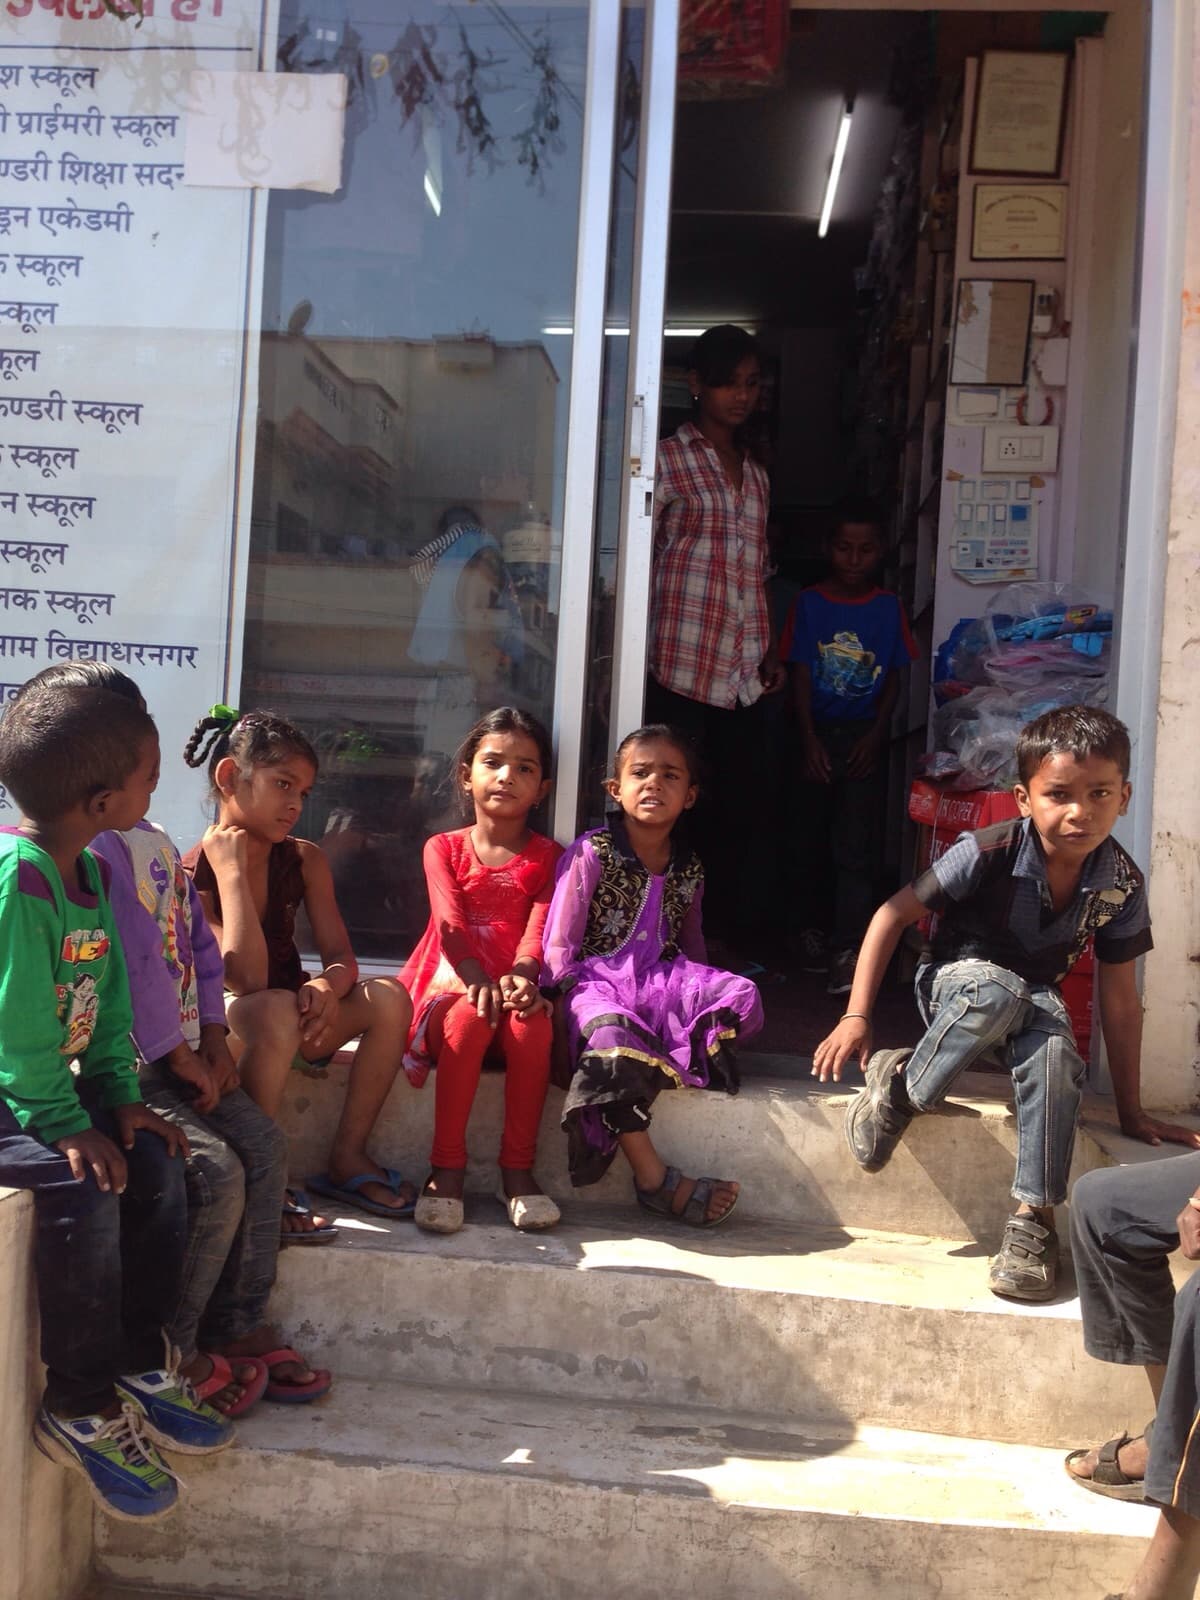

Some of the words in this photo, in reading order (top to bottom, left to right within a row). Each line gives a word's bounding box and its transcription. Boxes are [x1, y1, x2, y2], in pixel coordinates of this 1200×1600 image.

[28, 66, 99, 97] स्कूल
[16, 103, 105, 140] प्राईमरी
[111, 115, 179, 147] स्कूल
[58, 152, 128, 189] शिक्षा
[38, 197, 134, 237] एकेडमी
[14, 254, 84, 286] स्कूल
[72, 400, 144, 433] स्कूल
[8, 445, 79, 478] स्कूल
[25, 493, 97, 527] स्कूल
[0, 540, 69, 573] स्कूल
[44, 590, 116, 624] स्कूल
[45, 629, 199, 669] विद्याधरनगर
